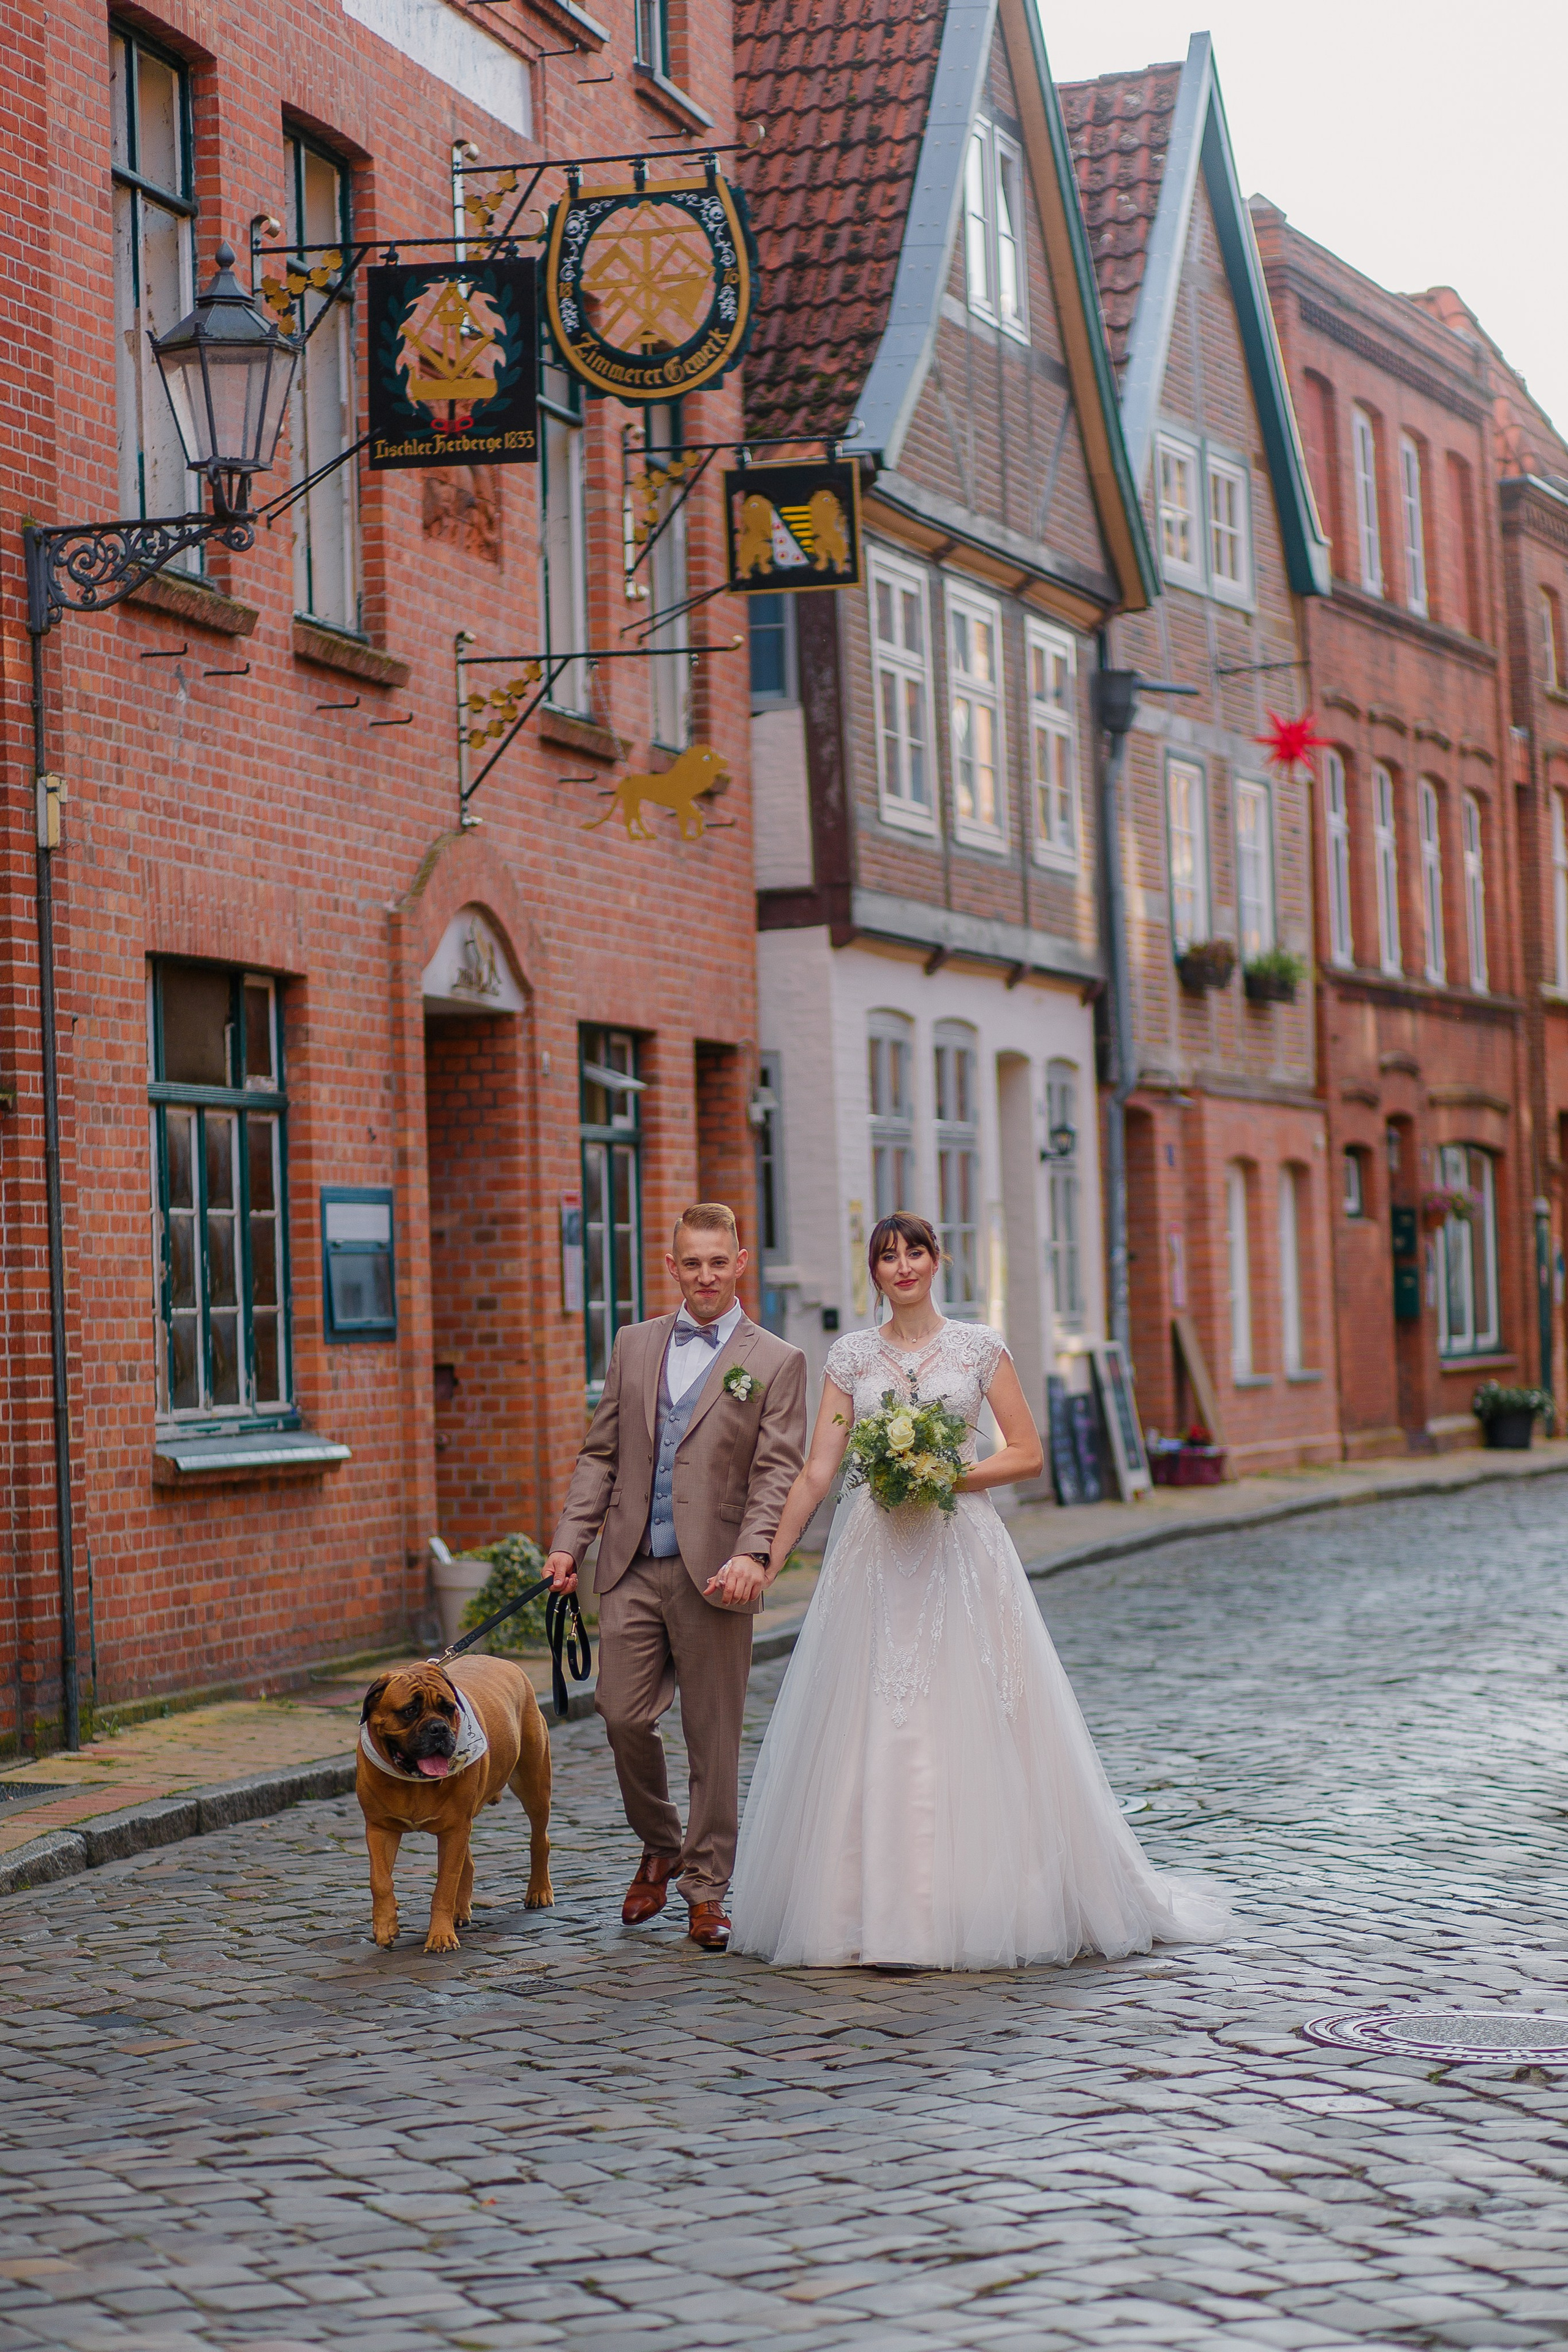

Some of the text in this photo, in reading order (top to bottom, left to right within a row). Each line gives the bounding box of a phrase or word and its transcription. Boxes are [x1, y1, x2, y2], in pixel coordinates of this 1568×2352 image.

[557, 282, 573, 298] 18
[571, 327, 731, 385] Zimmerer Gewerk
[374, 430, 536, 459] Tischler Herberge 1833
